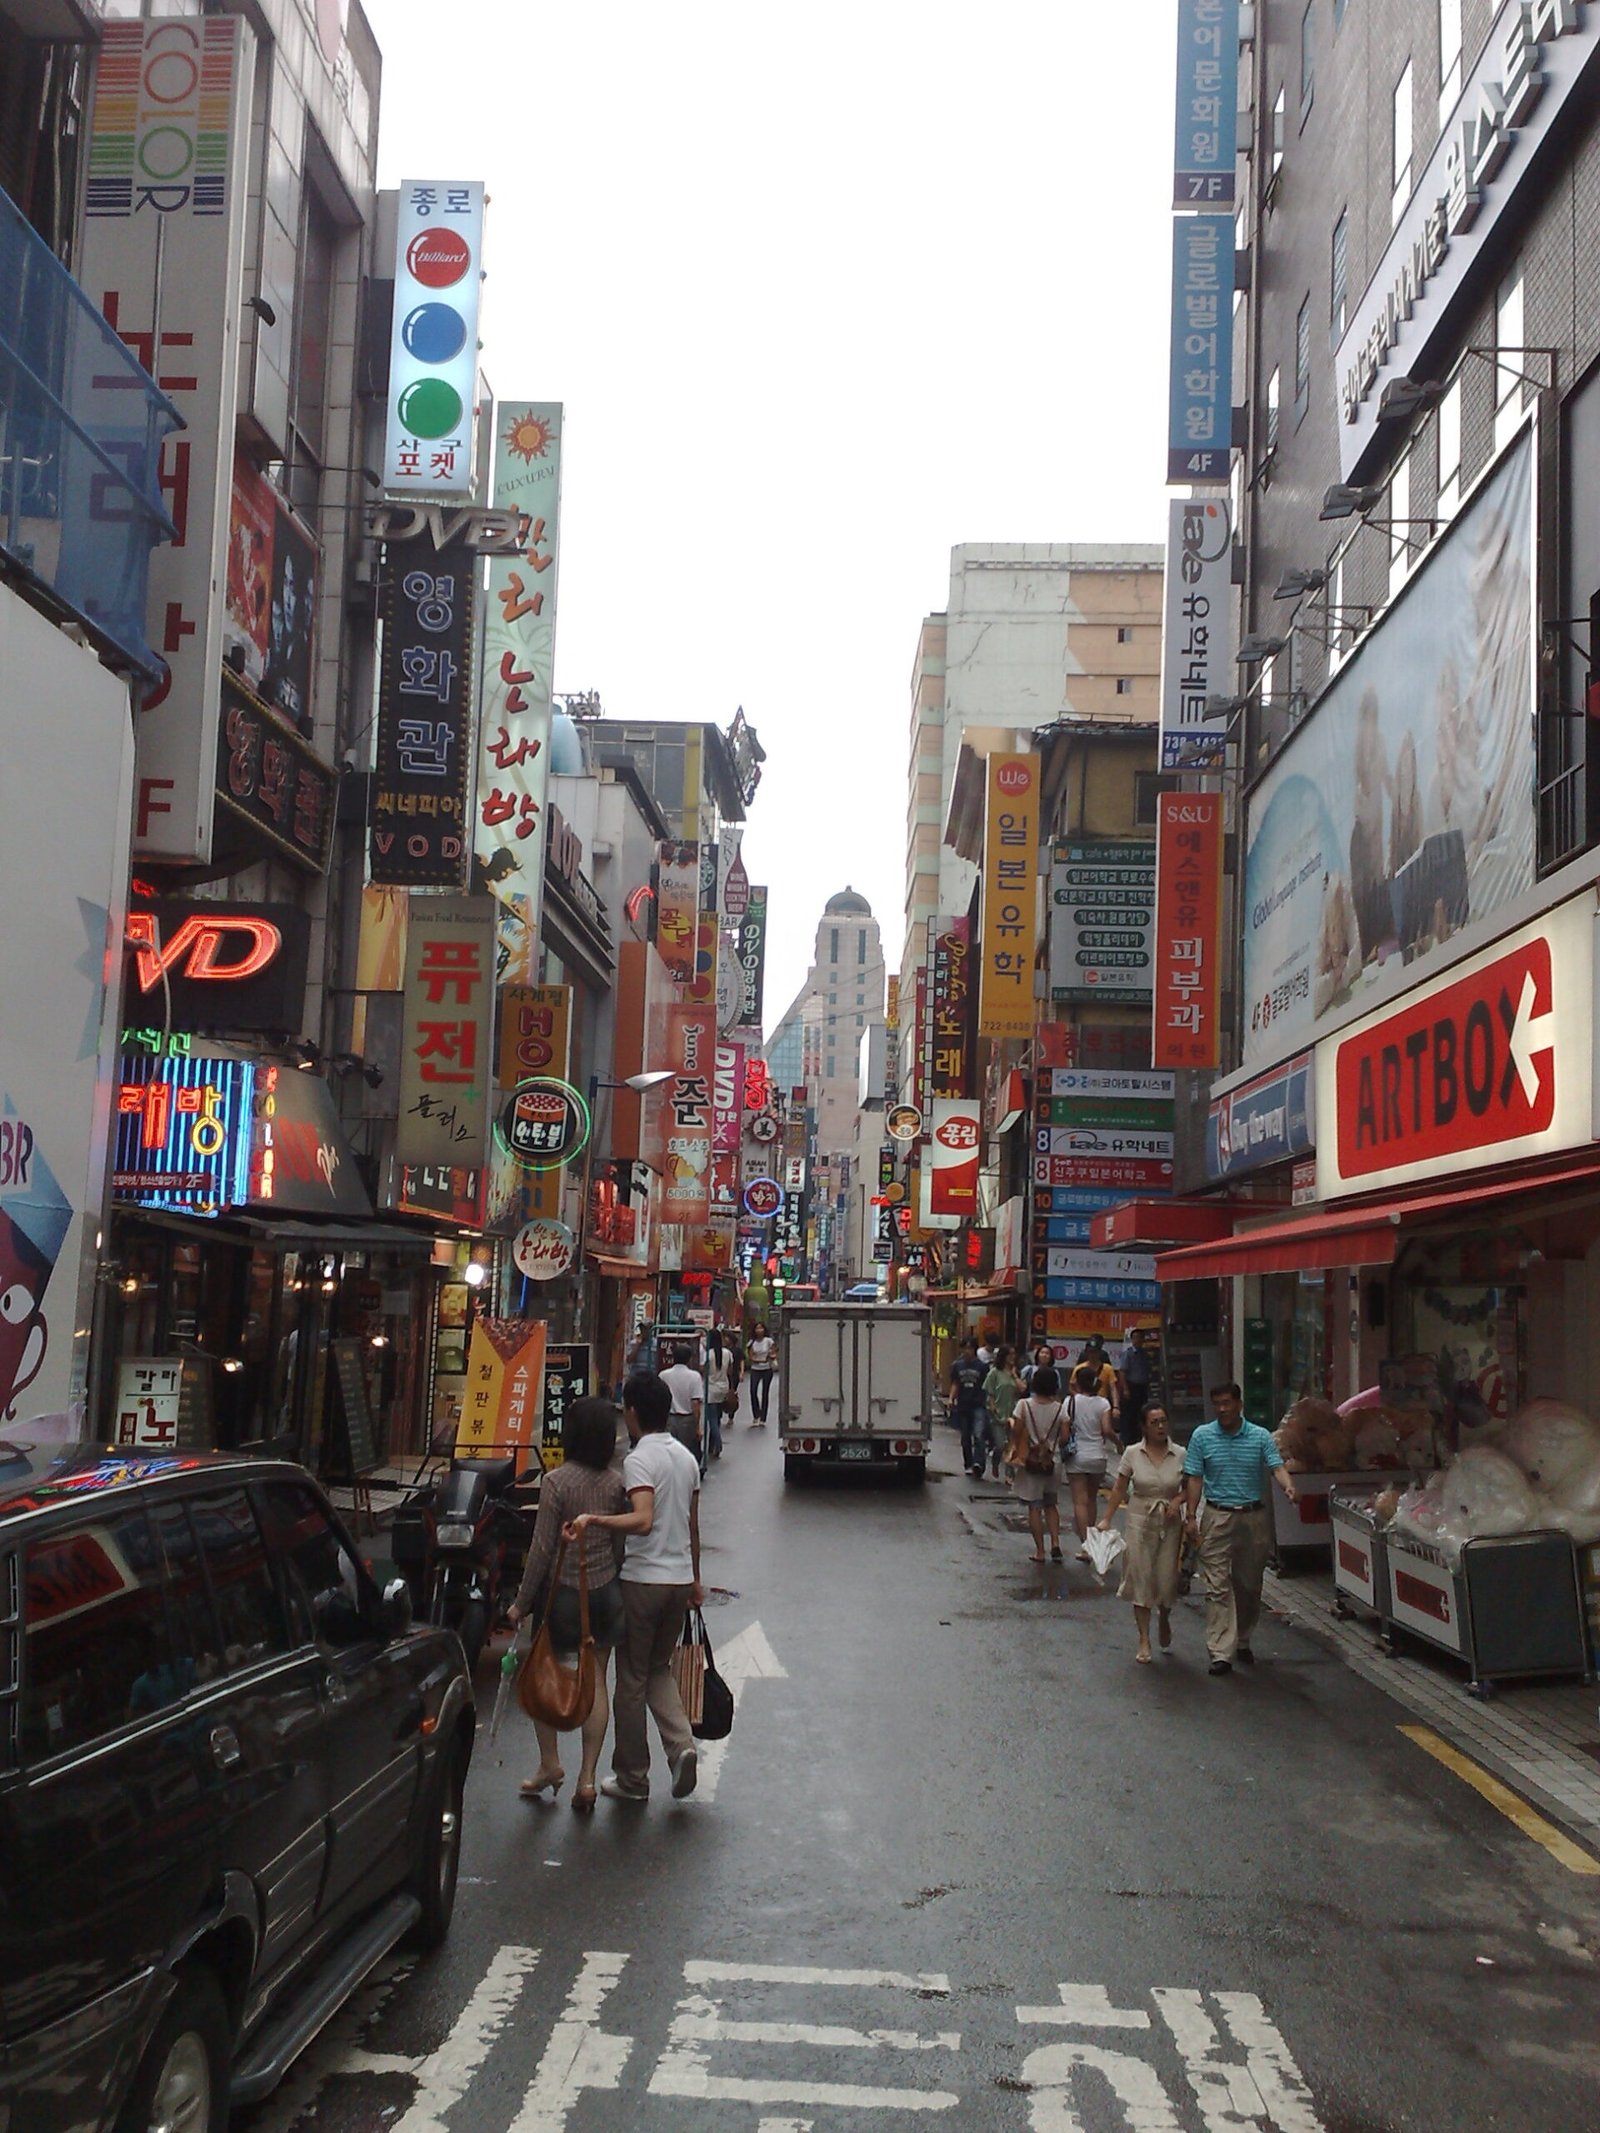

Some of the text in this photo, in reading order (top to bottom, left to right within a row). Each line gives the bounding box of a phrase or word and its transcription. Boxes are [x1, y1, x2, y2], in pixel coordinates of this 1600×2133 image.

[410, 187, 471, 216] 종로
[1189, 178, 1221, 198] 7F
[417, 251, 467, 264] Billiard
[1184, 225, 1220, 441] 글로벌어학원
[396, 439, 464, 452] 사구
[396, 452, 455, 480] 포켓
[1187, 453, 1212, 472] 4F
[1180, 592, 1210, 725] 유학네트
[397, 571, 459, 775] 영화관
[481, 651, 540, 840] 노래방
[999, 770, 1029, 786] We
[375, 791, 463, 819] 씨네피아
[1167, 805, 1212, 823] S&U
[375, 833, 461, 859] VOD
[994, 813, 1027, 985] 일본유학
[1167, 937, 1205, 1035] 피부과
[415, 940, 483, 1084] 퓨전
[516, 1006, 553, 1087] HO
[714, 1047, 737, 1109] DVD
[1355, 985, 1520, 1150] ARTBOX
[1040, 1104, 1050, 1118] 9
[1037, 1130, 1049, 1152] 8
[1112, 1139, 1170, 1153] 유학네트
[1036, 1160, 1048, 1181] 8
[1034, 1284, 1045, 1299] 4
[1063, 1281, 1157, 1297] 글로벌어학원
[1034, 1314, 1045, 1330] 6
[507, 1365, 529, 1433] 스파게티
